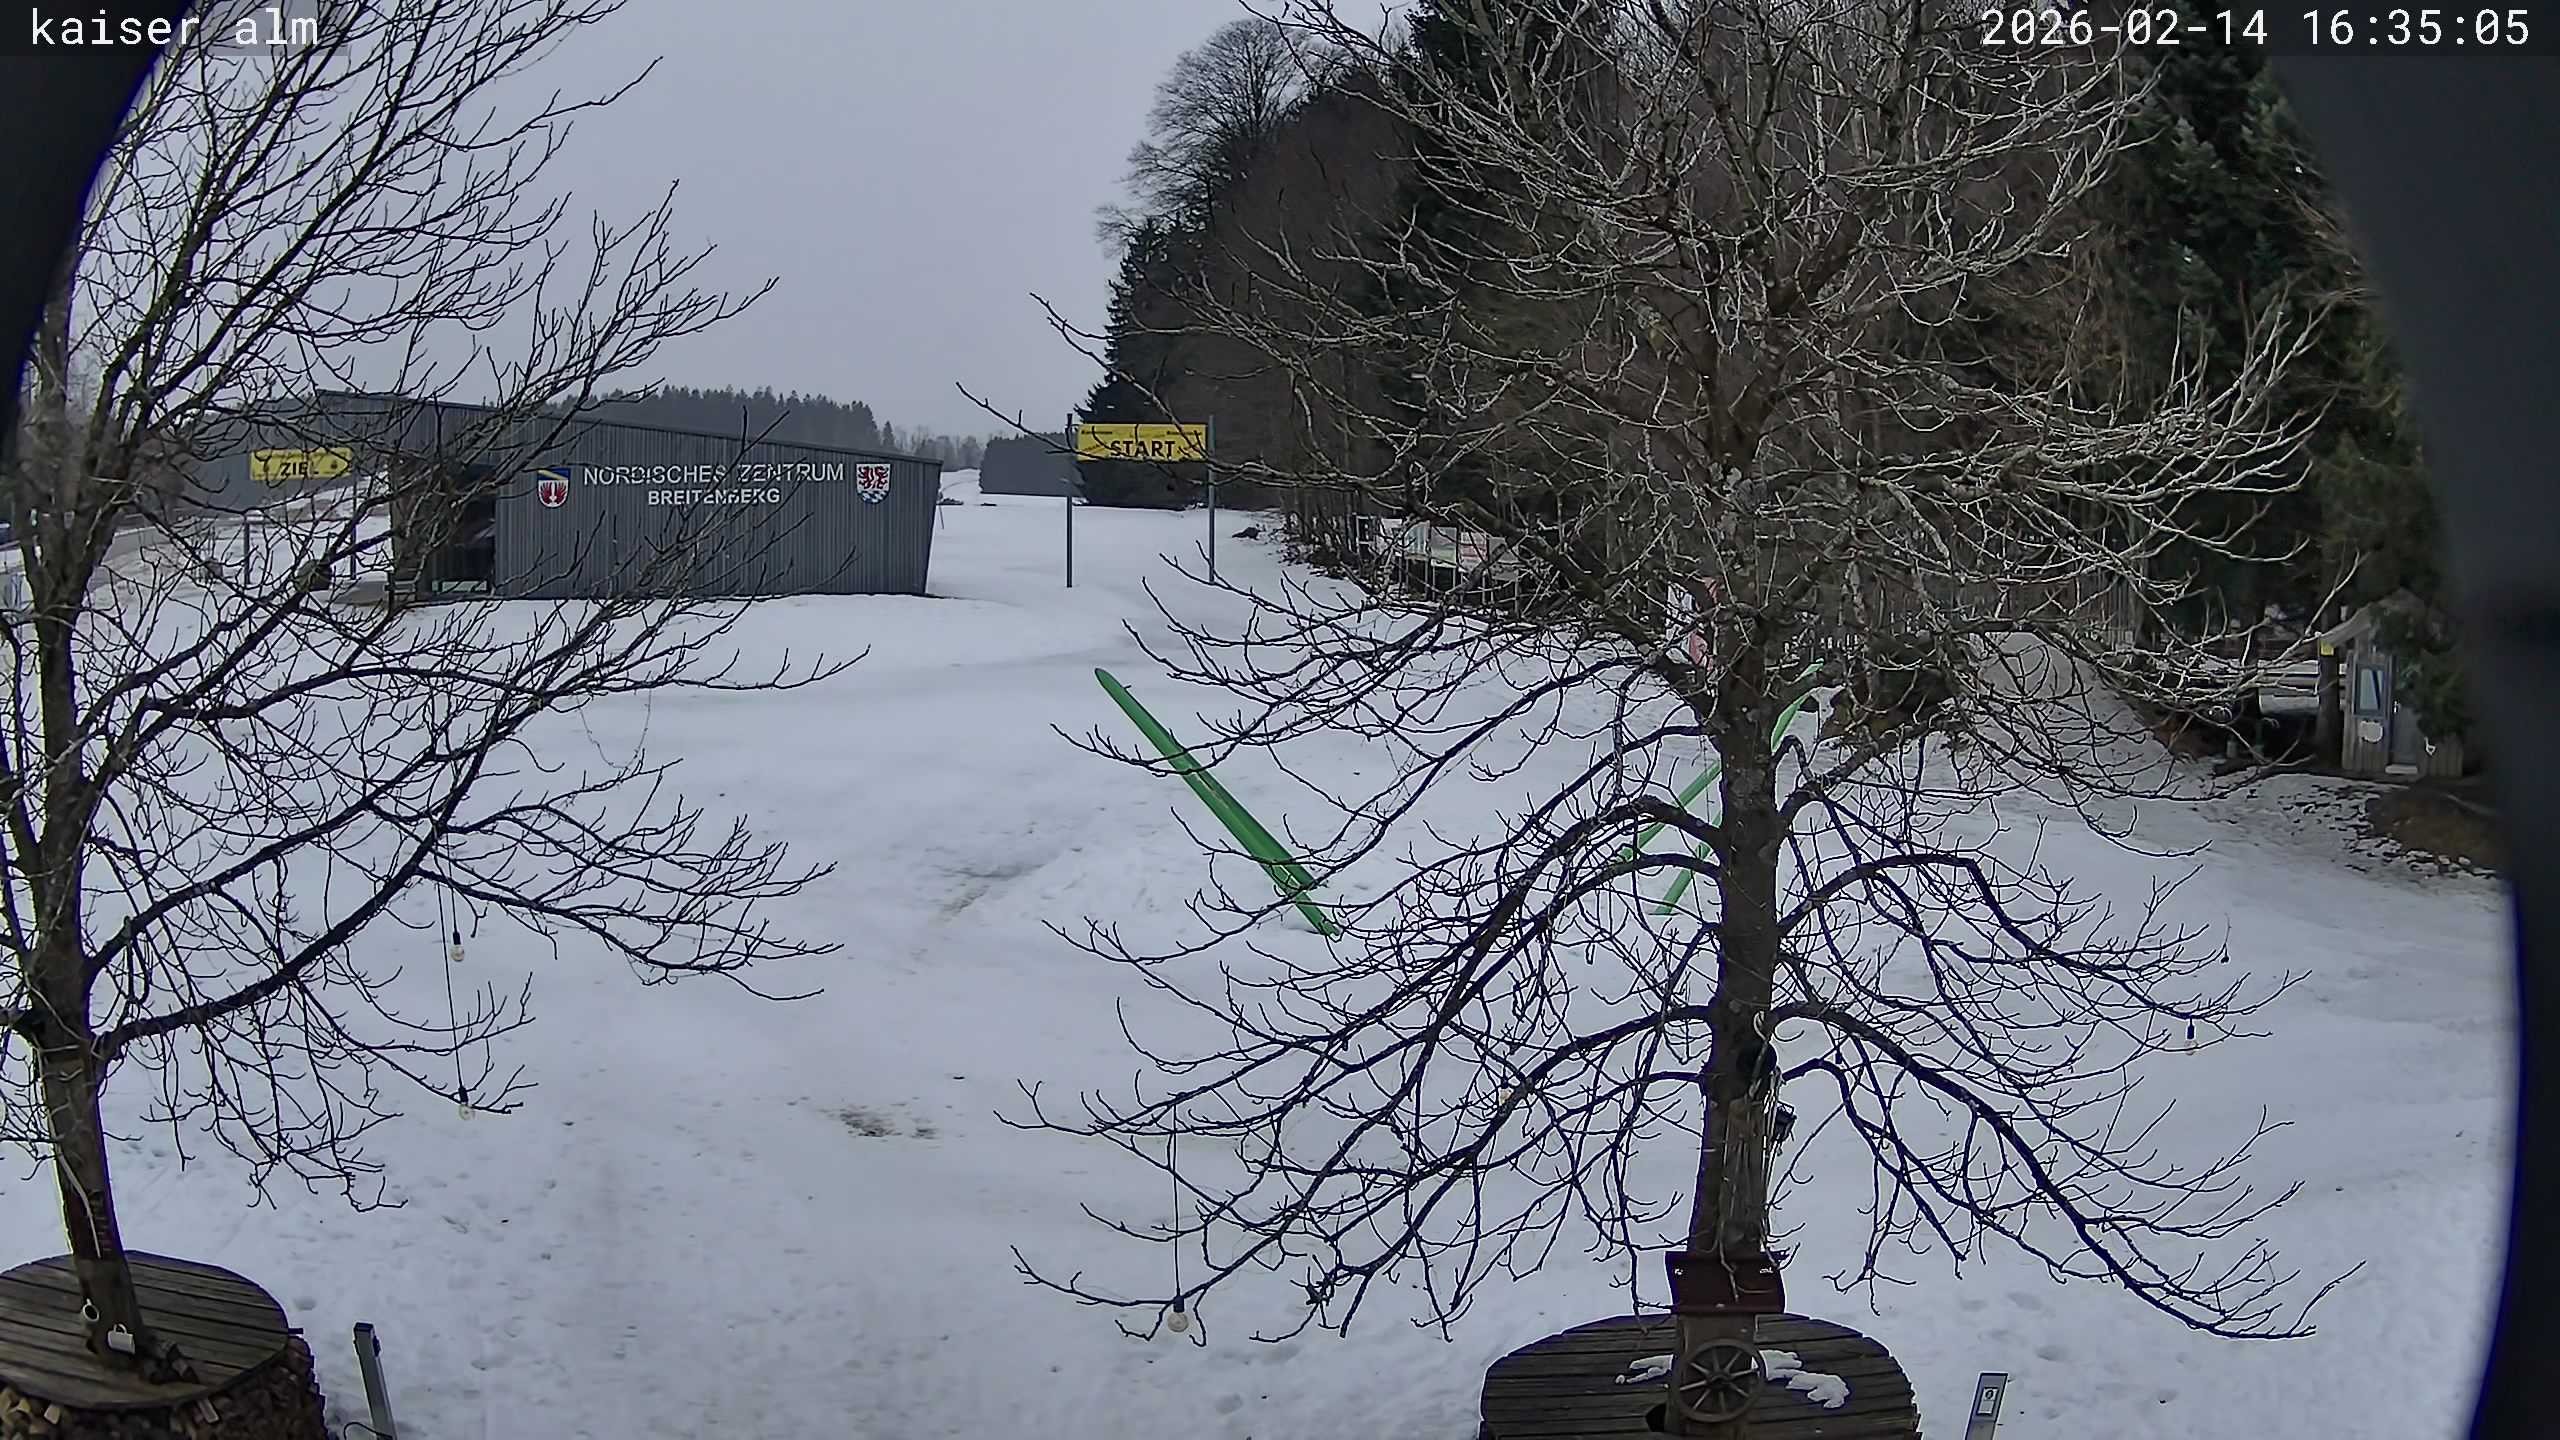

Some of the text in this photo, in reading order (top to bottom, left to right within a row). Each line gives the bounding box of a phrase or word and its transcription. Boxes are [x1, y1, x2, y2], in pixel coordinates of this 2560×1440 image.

[1110, 440, 1176, 457] START
[584, 463, 844, 485] NORDISCHES ZENTRUM
[648, 487, 780, 505] BREITENBERG
